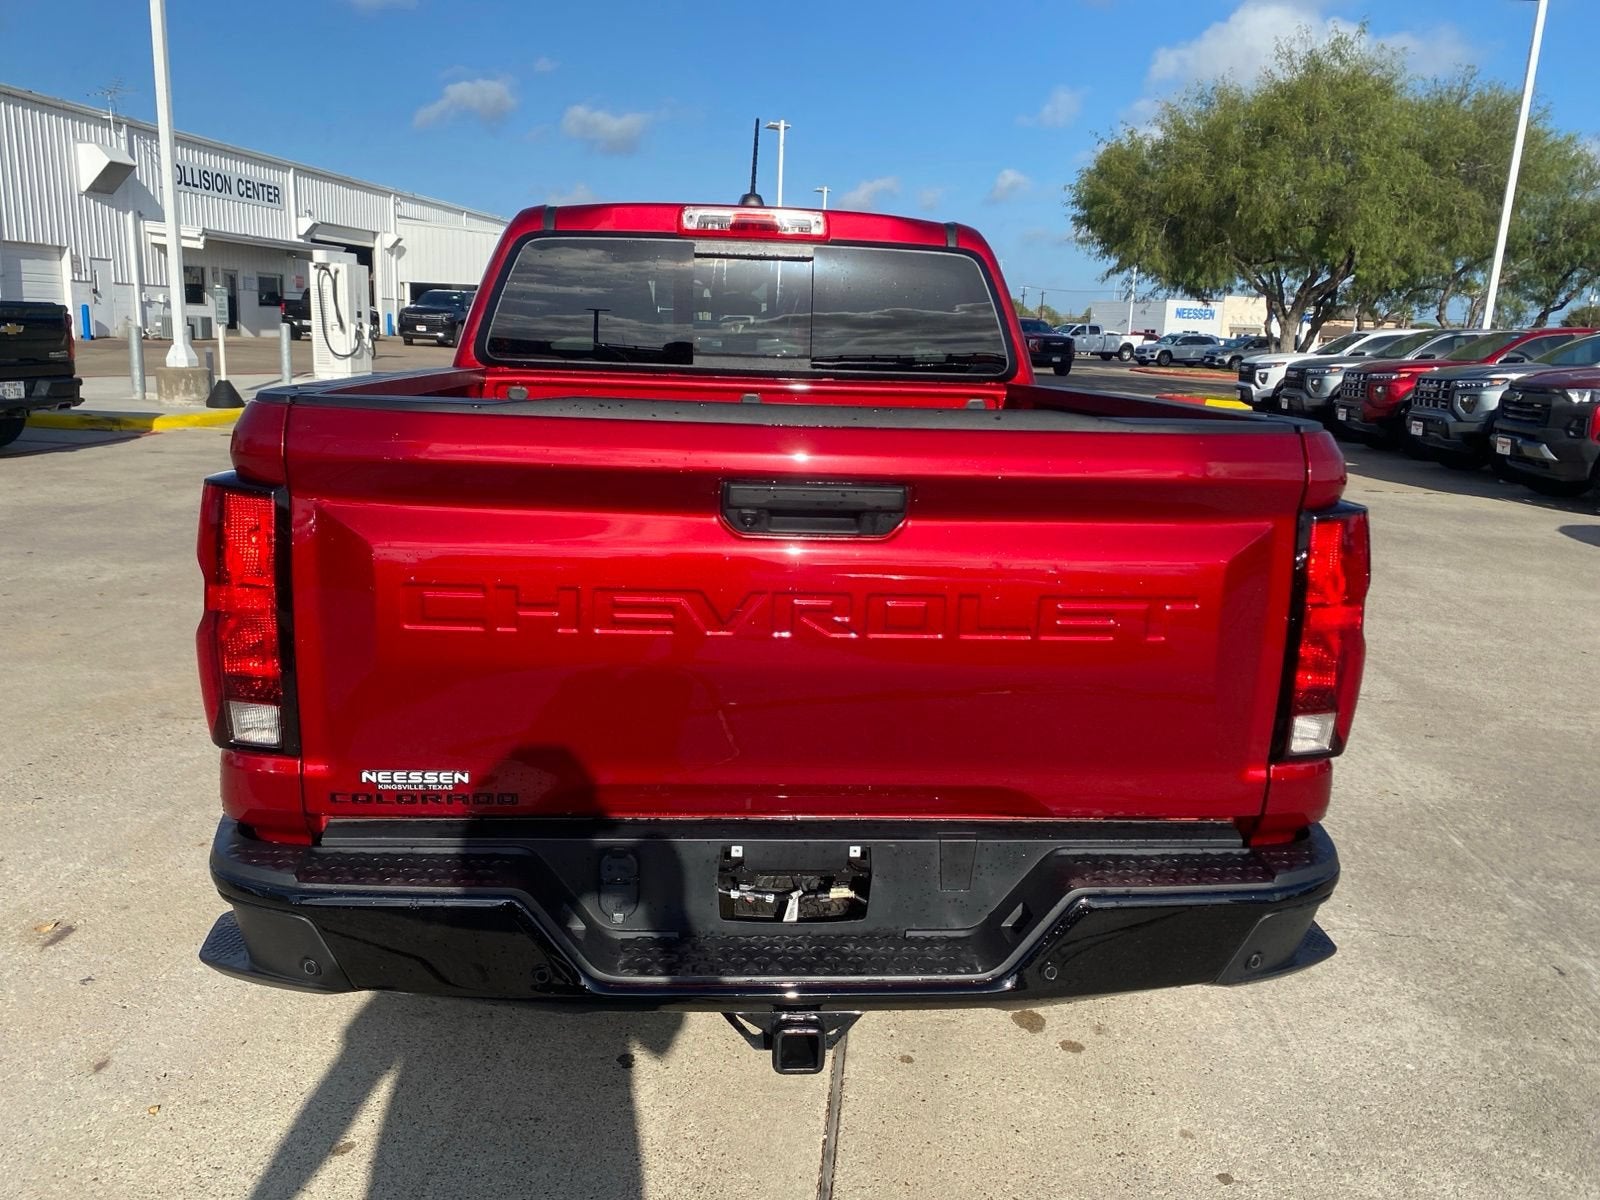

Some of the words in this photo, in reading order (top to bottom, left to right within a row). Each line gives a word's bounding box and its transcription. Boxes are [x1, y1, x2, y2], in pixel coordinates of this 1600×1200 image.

[176, 163, 232, 195] OLLISION
[237, 178, 281, 204] CENTER
[1175, 307, 1215, 320] NEESSEN
[402, 582, 1200, 641] CHEVROLET
[361, 770, 469, 784] NEESSEN
[331, 792, 518, 805] COLORADO
